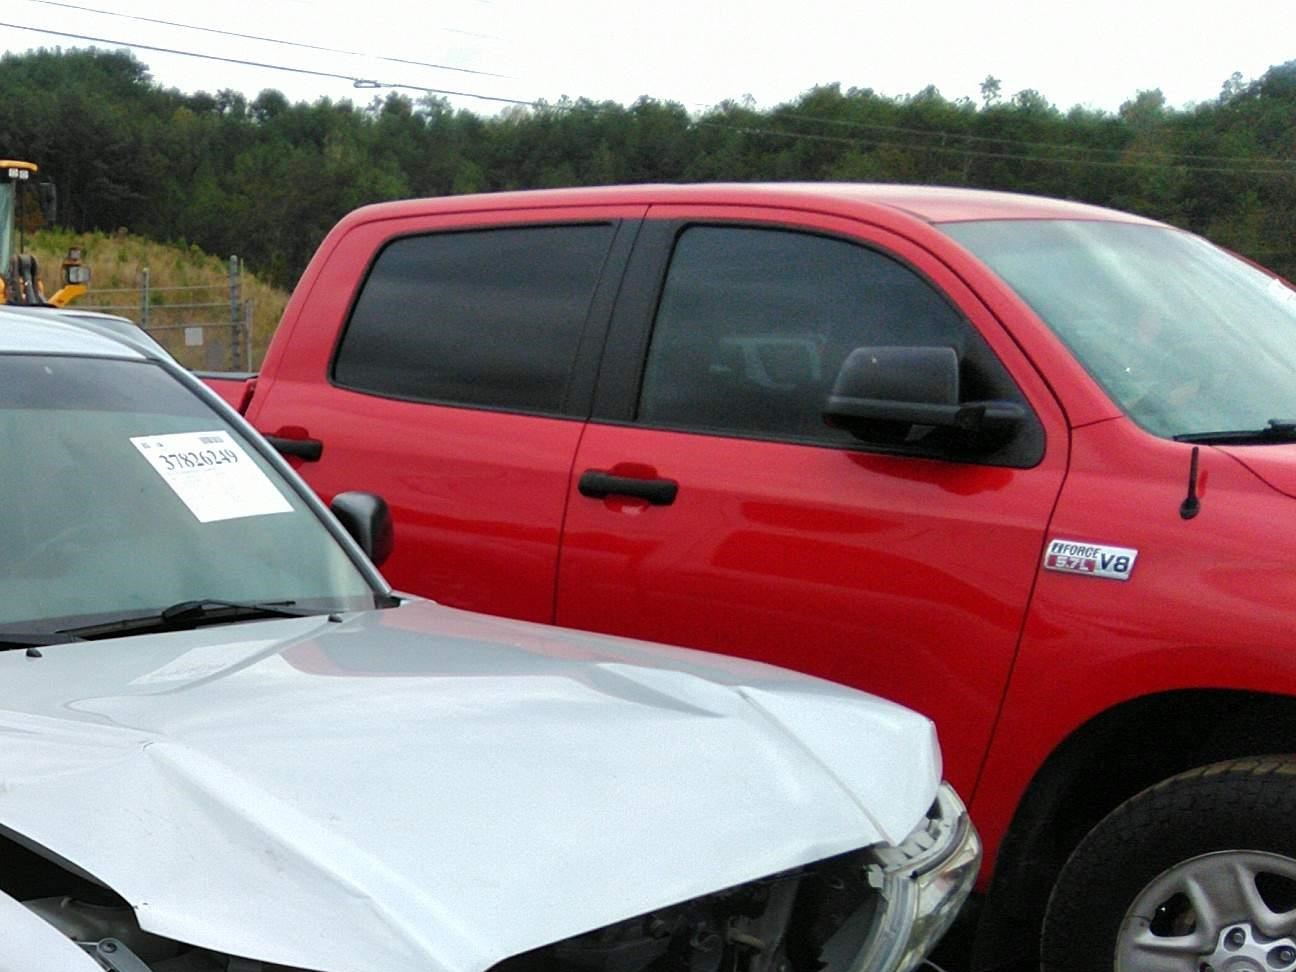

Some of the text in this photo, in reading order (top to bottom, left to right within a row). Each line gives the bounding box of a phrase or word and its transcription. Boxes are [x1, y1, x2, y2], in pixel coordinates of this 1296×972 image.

[159, 448, 239, 471] 37826249
[1055, 556, 1090, 571] 5.7L
[1100, 552, 1131, 573] V8
